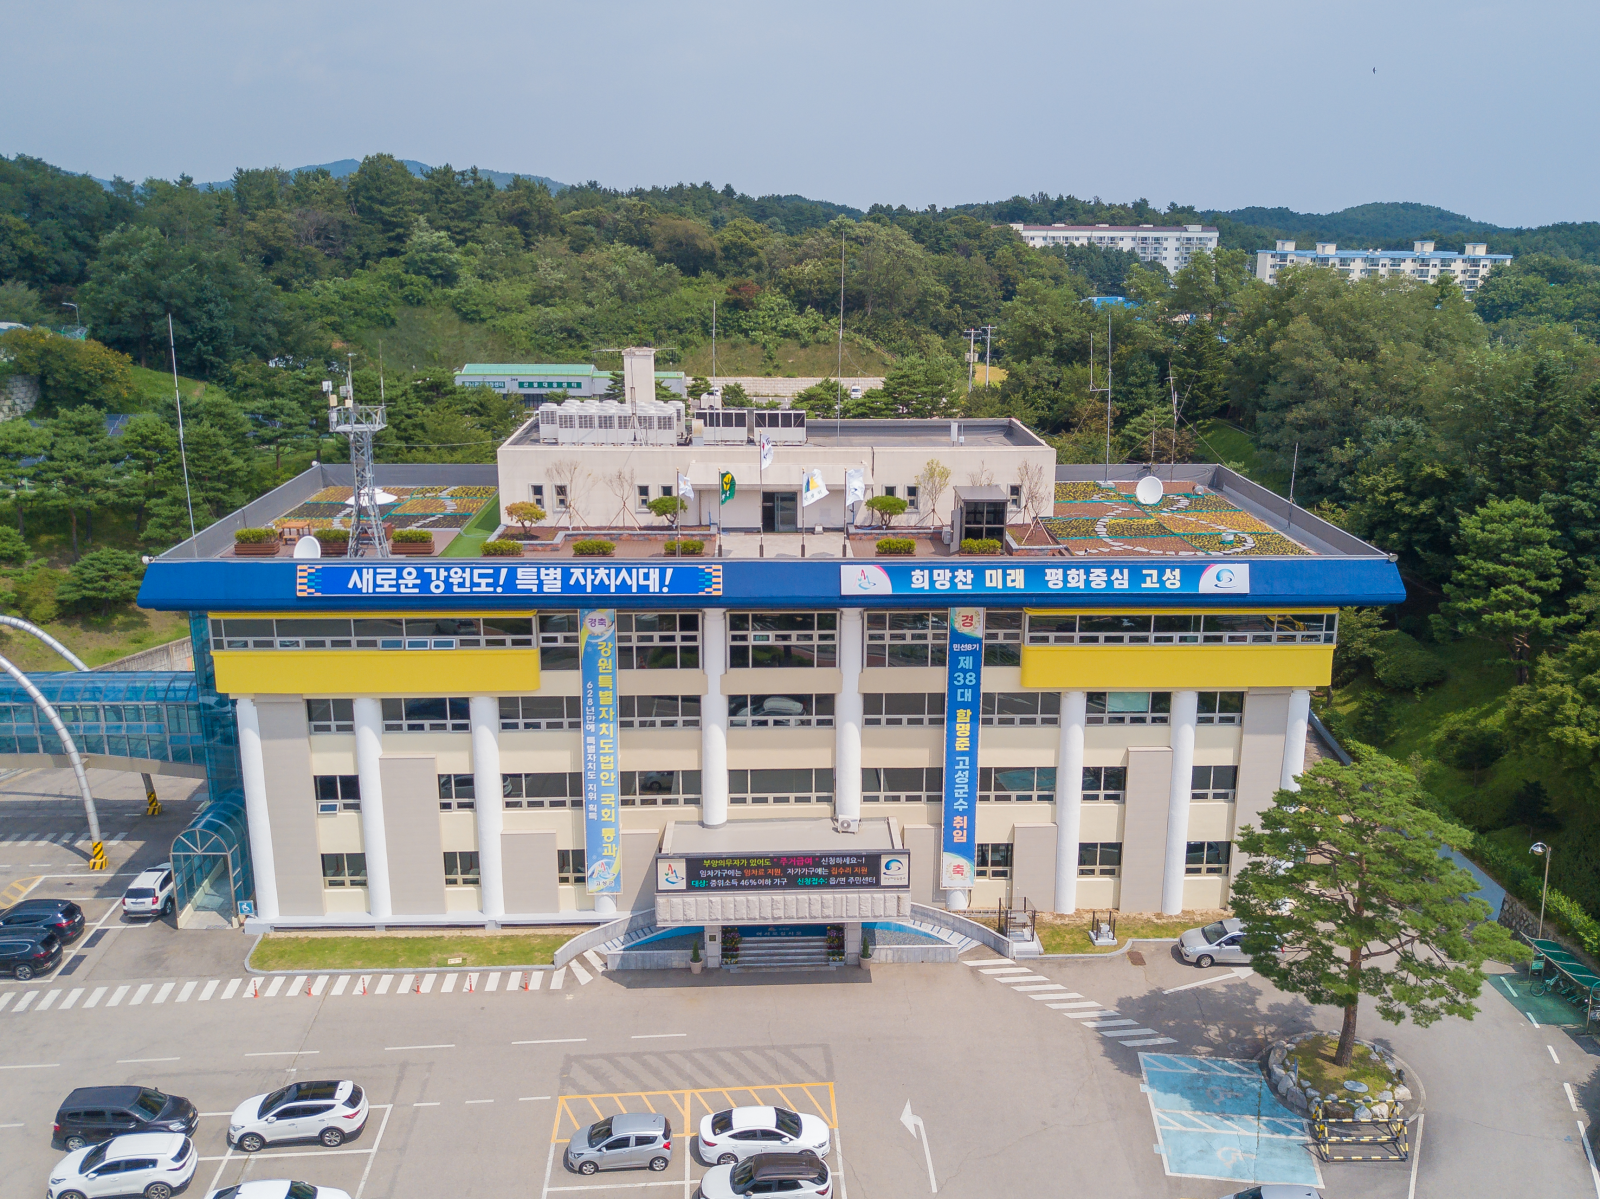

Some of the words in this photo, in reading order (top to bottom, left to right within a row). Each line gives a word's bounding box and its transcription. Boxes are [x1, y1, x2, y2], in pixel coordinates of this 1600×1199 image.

[347, 567, 421, 593] 새로운
[423, 567, 508, 593] 강원도!
[516, 567, 562, 593] 특별
[569, 567, 674, 593] 자치시대!
[910, 568, 974, 590] 희망찬
[985, 568, 1025, 590] 미래
[1044, 568, 1129, 590] 평화중심
[1140, 568, 1181, 590] 고성
[588, 617, 607, 628] 경축
[961, 615, 974, 628] 경
[952, 643, 979, 652] 민선8기
[586, 681, 596, 733] 628년만에
[597, 641, 616, 787] 강원특별자치도법안
[586, 736, 597, 780] 특별자치도
[588, 783, 597, 801] 지위
[953, 756, 970, 812] 고성군수
[601, 793, 616, 823] 국회
[952, 815, 968, 843] 취임
[602, 828, 618, 858] 통과
[700, 869, 742, 878] 임차가구에는
[743, 868, 765, 876] 임차료
[786, 866, 829, 876] 자가가구에는
[831, 866, 852, 875] 집수리
[853, 866, 868, 875] 지원
[703, 858, 748, 868] 부양의무자가
[749, 858, 772, 867] 있어도
[952, 864, 965, 876] 축
[691, 879, 709, 888] 대상:
[710, 878, 738, 887] 중위소득
[773, 877, 788, 885] 가구
[797, 877, 828, 886] 신청접수:
[848, 876, 876, 885] 주민센터
